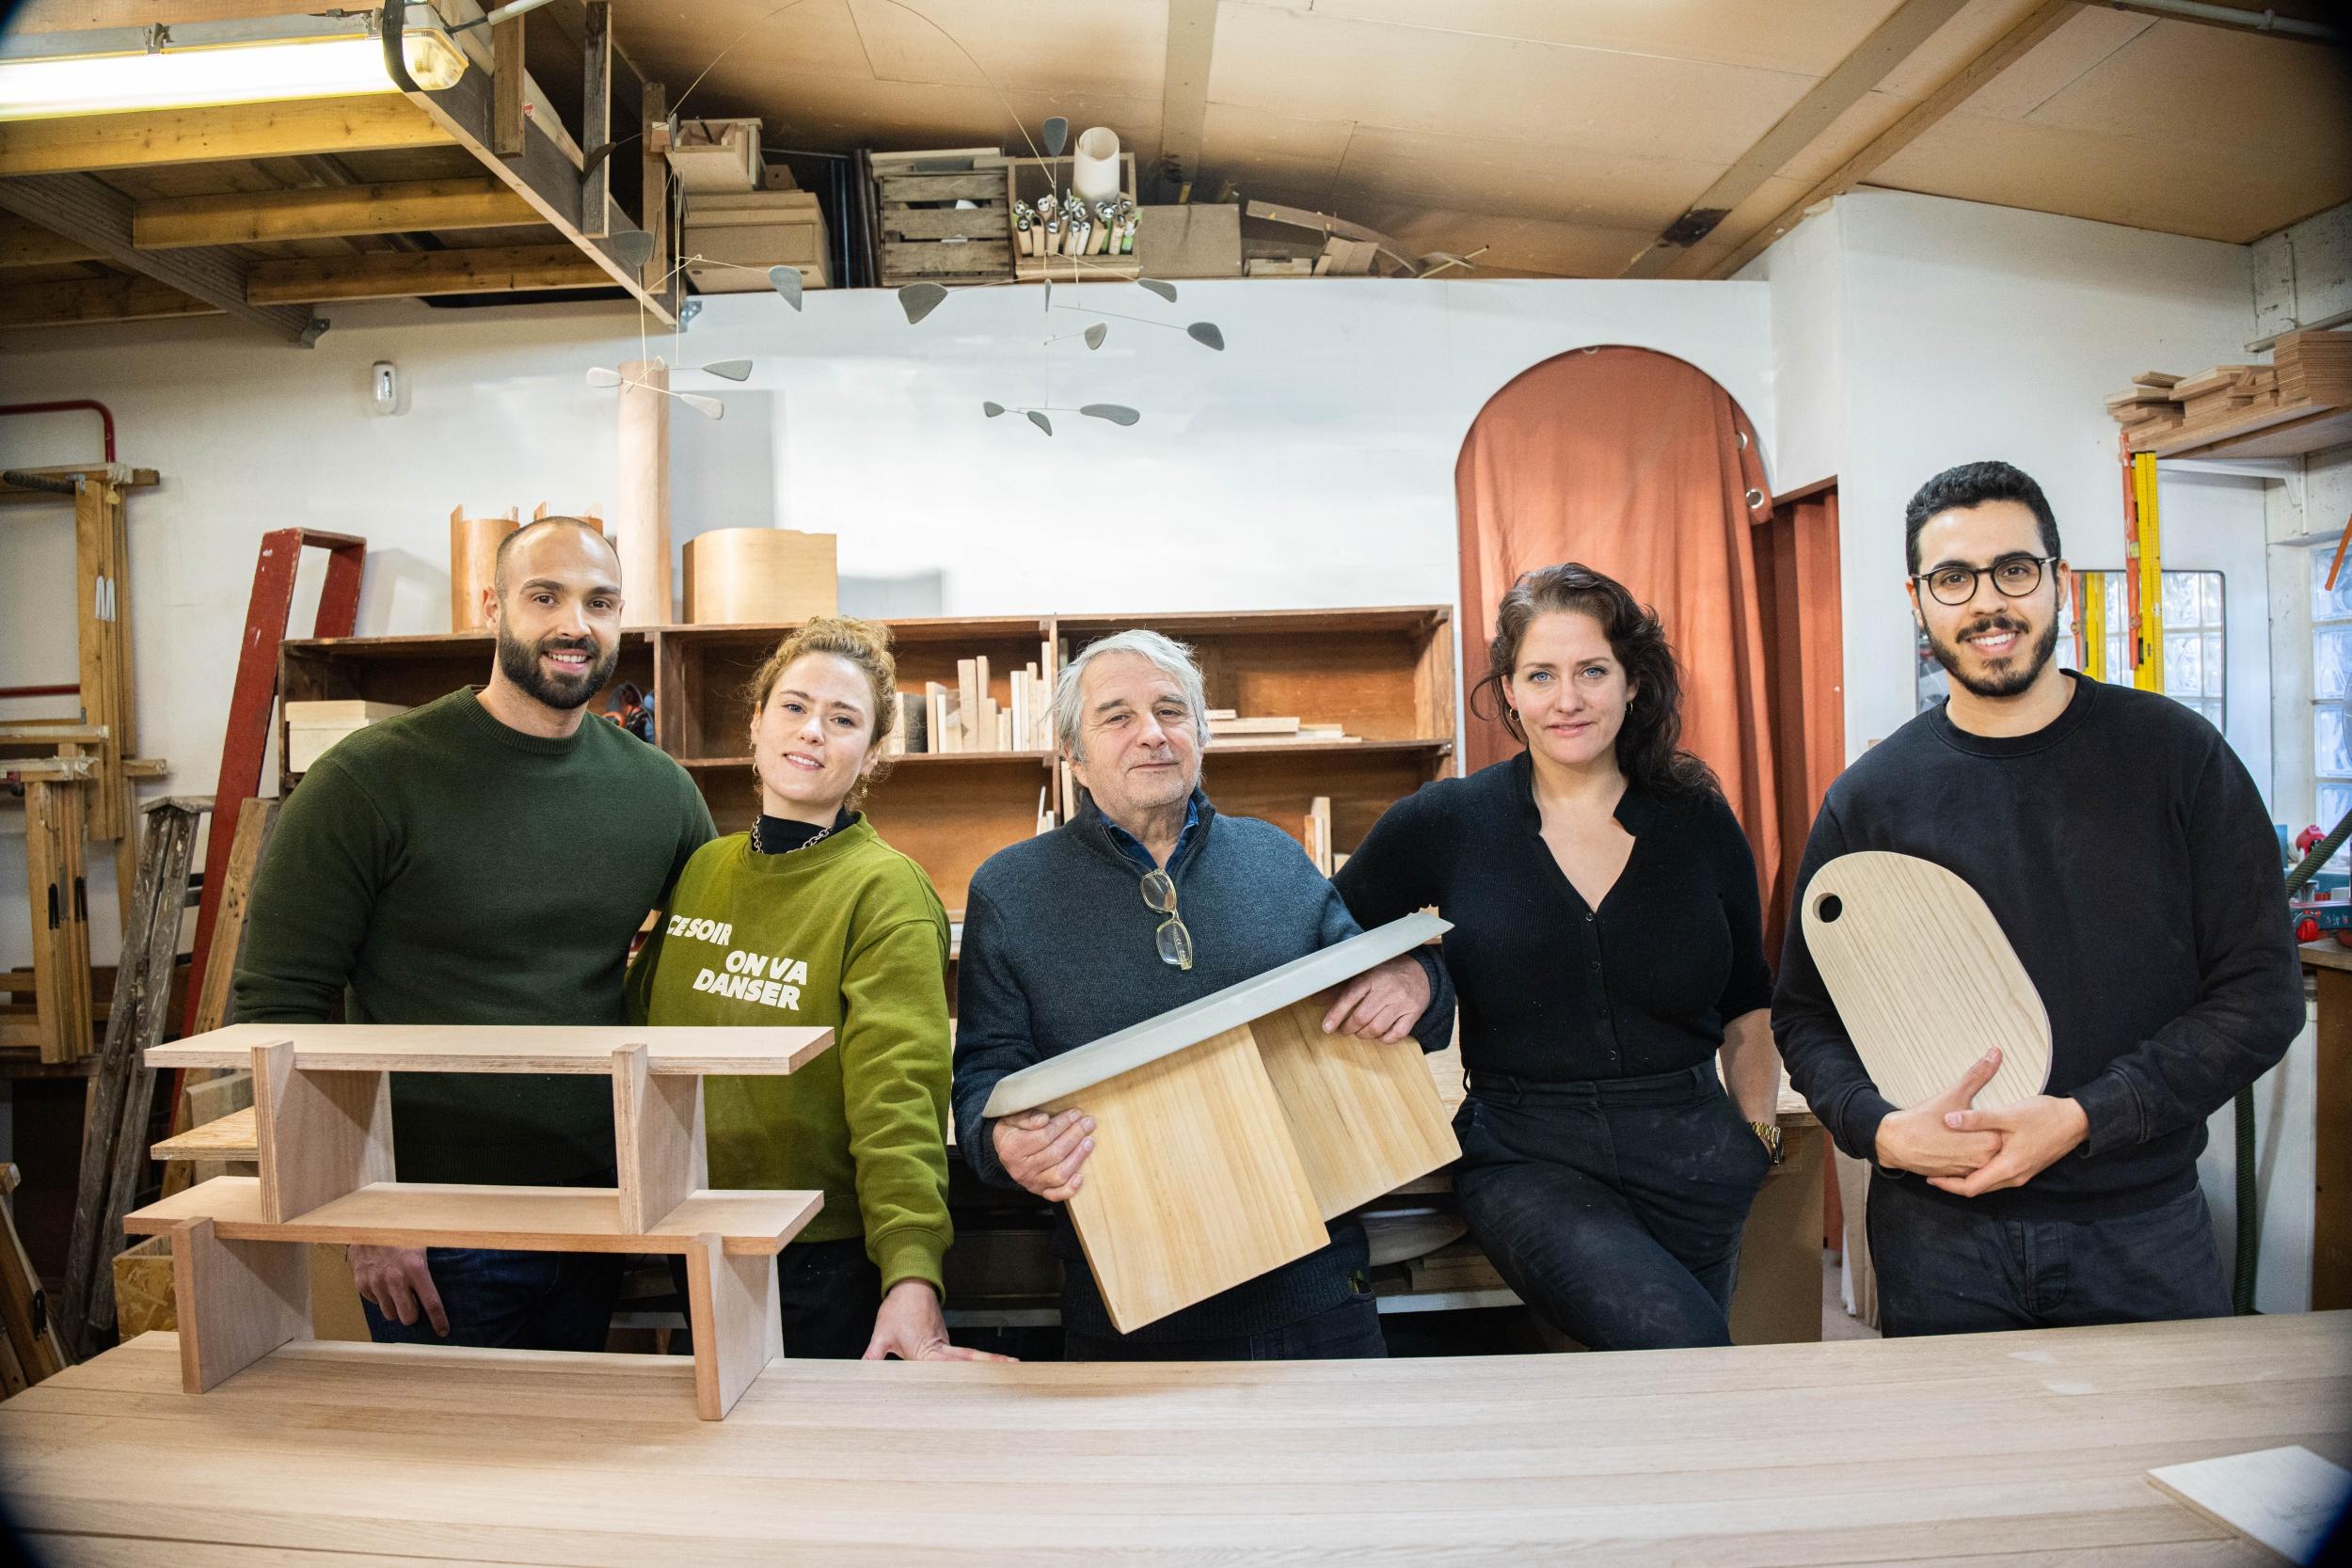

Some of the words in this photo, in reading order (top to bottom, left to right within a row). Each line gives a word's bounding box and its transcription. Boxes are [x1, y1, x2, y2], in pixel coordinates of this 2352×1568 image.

[666, 914, 691, 937] CE
[684, 918, 733, 946] SOIR
[725, 950, 769, 977] ON
[770, 957, 807, 986] VA
[692, 968, 801, 1011] DANSER
